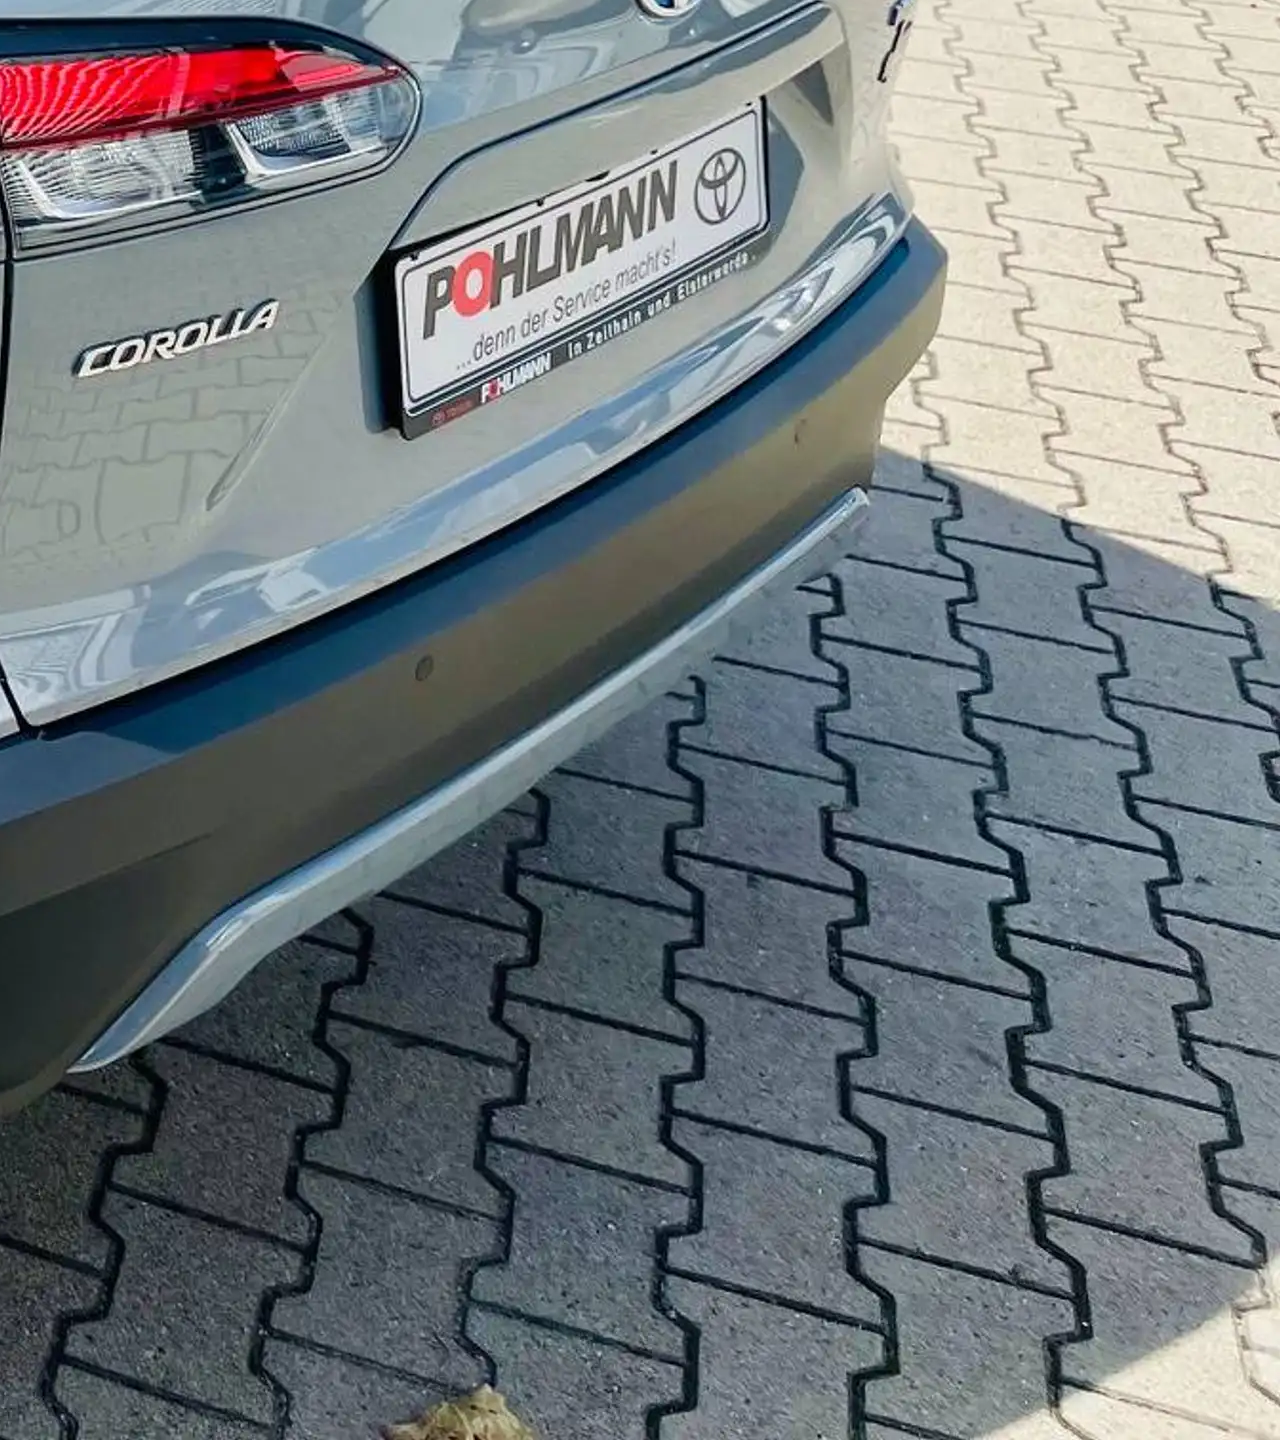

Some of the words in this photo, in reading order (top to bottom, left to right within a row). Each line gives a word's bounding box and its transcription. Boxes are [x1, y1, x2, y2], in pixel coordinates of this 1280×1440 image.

[424, 159, 678, 339] POHLMANN
[72, 298, 280, 378] COROLLA
[481, 352, 552, 404] POHLMANN
[647, 291, 673, 317] und
[521, 307, 550, 339] der
[553, 279, 613, 322] Service
